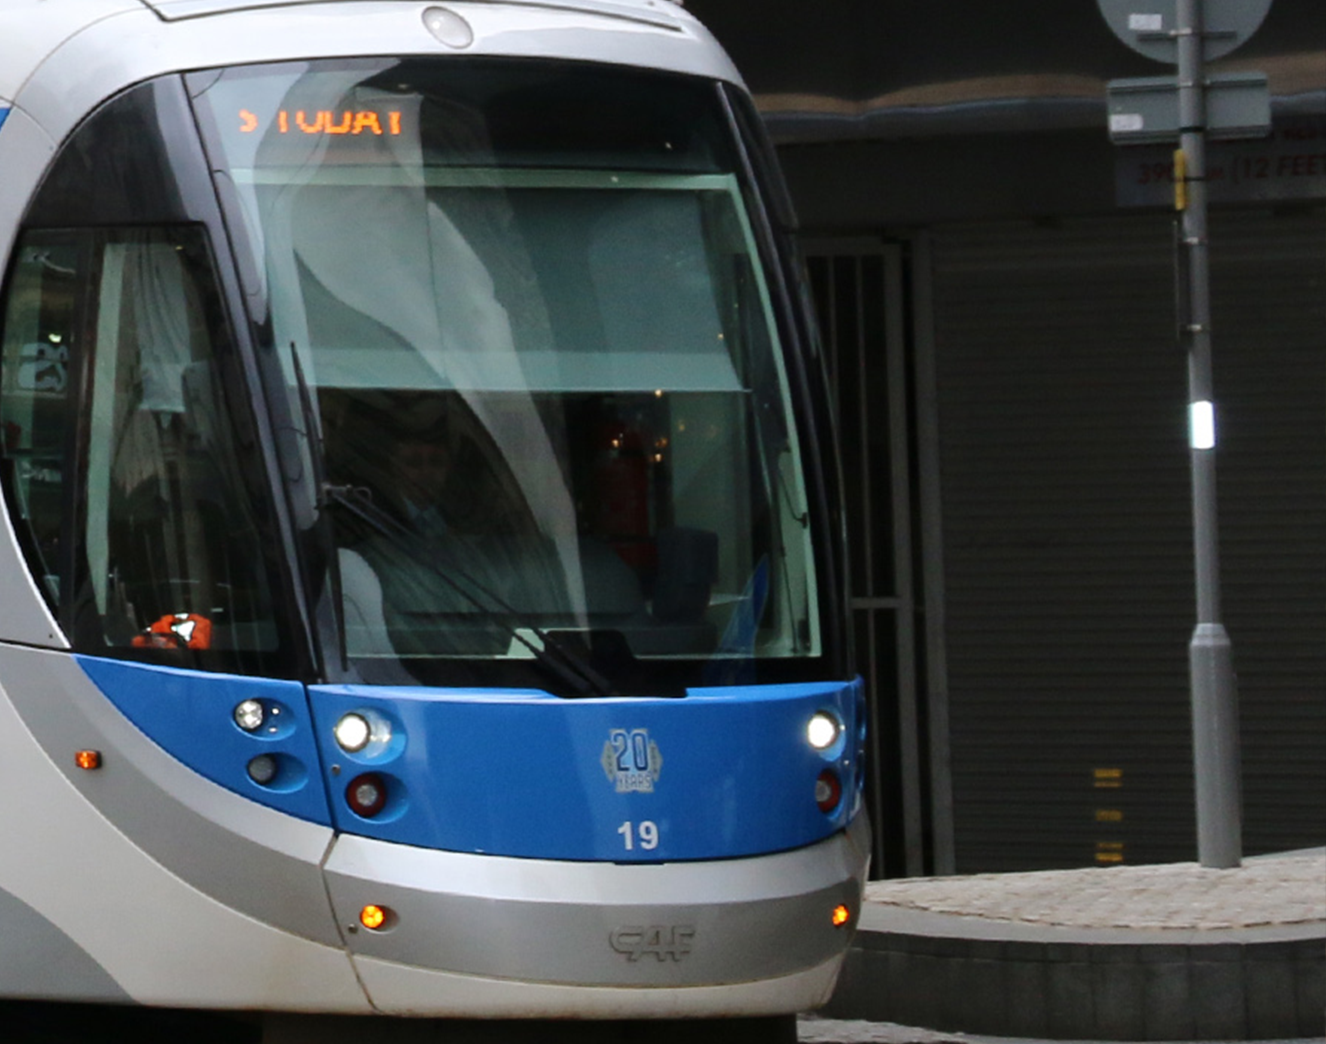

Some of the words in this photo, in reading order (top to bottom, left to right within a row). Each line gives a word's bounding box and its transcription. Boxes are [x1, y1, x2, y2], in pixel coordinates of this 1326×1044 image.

[611, 731, 650, 772] 20
[616, 773, 653, 790] YEARS
[617, 820, 659, 850] 19
